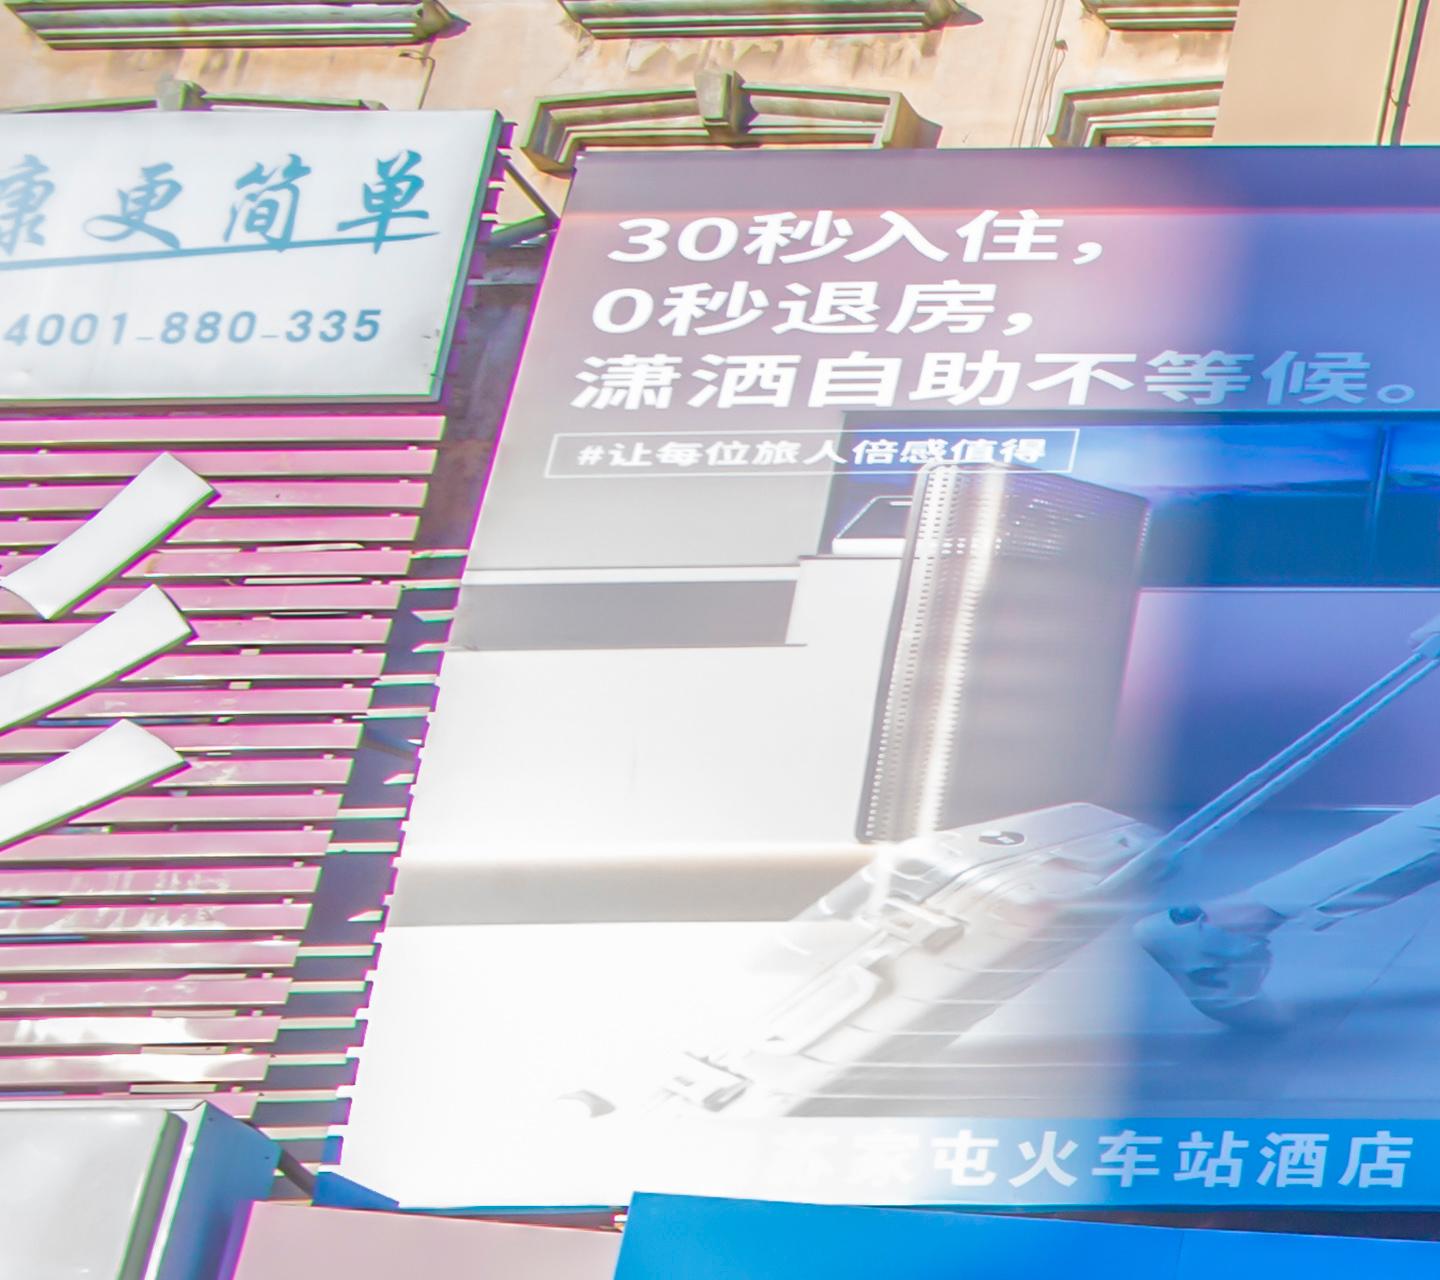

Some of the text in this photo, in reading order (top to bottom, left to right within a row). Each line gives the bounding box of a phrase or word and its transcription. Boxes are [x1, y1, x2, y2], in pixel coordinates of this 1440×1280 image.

[0, 149, 430, 256] 康更简单
[3, 309, 382, 346] 4001-880-335
[570, 349, 1416, 410] 潇洒自助不等候。
